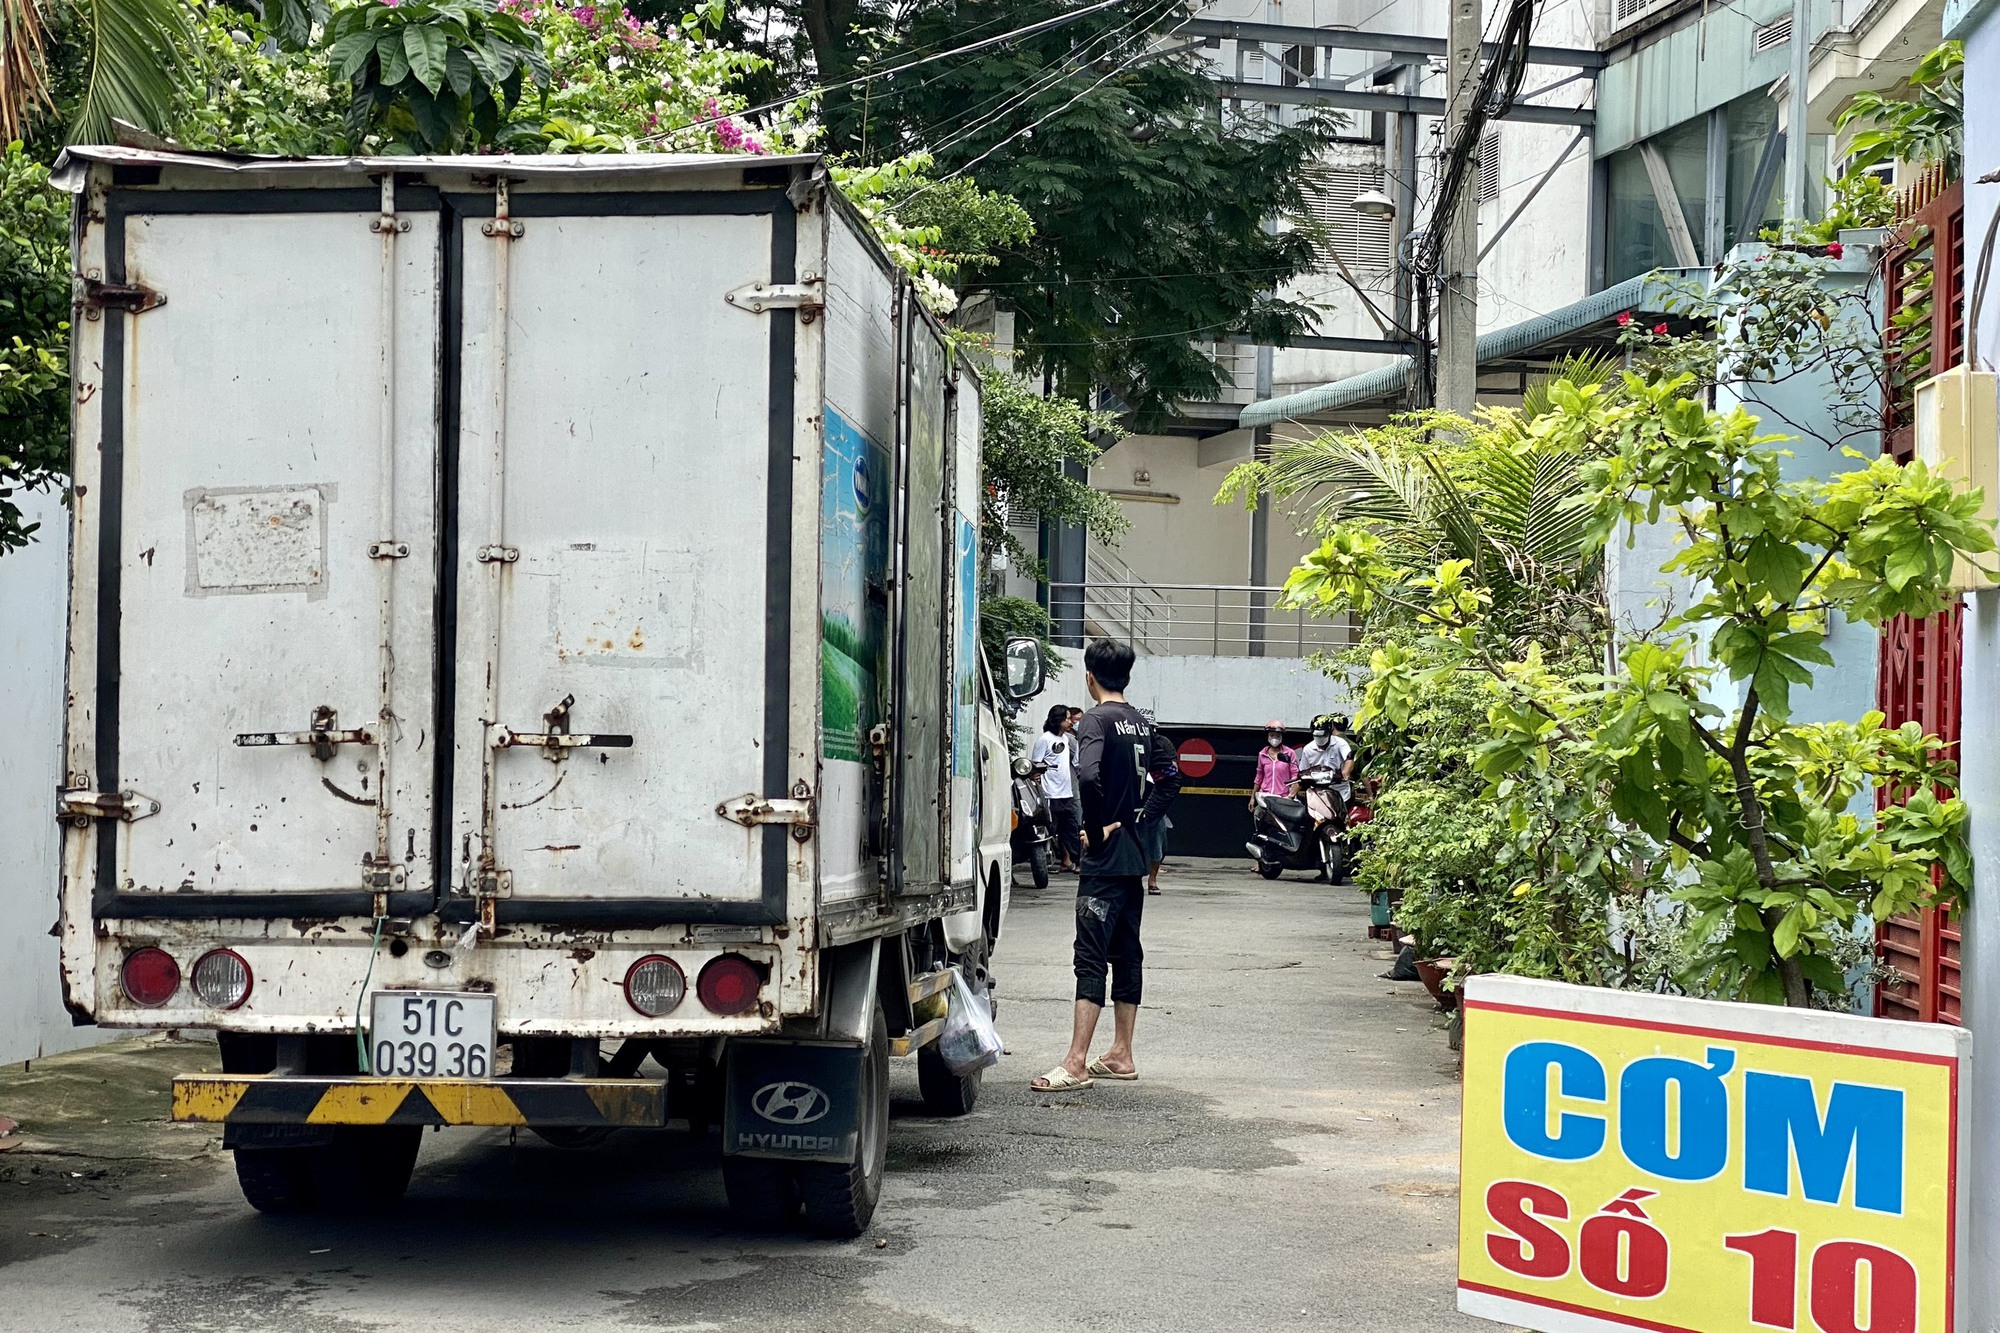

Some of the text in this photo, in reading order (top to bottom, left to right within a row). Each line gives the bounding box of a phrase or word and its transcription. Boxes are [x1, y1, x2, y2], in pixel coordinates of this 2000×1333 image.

[402, 998, 464, 1037] 51C
[375, 1040, 486, 1078] 039.36
[738, 1133, 839, 1151] HYUNDAI
[1503, 1041, 1904, 1216] CƠM
[1725, 1227, 1918, 1333] 10
